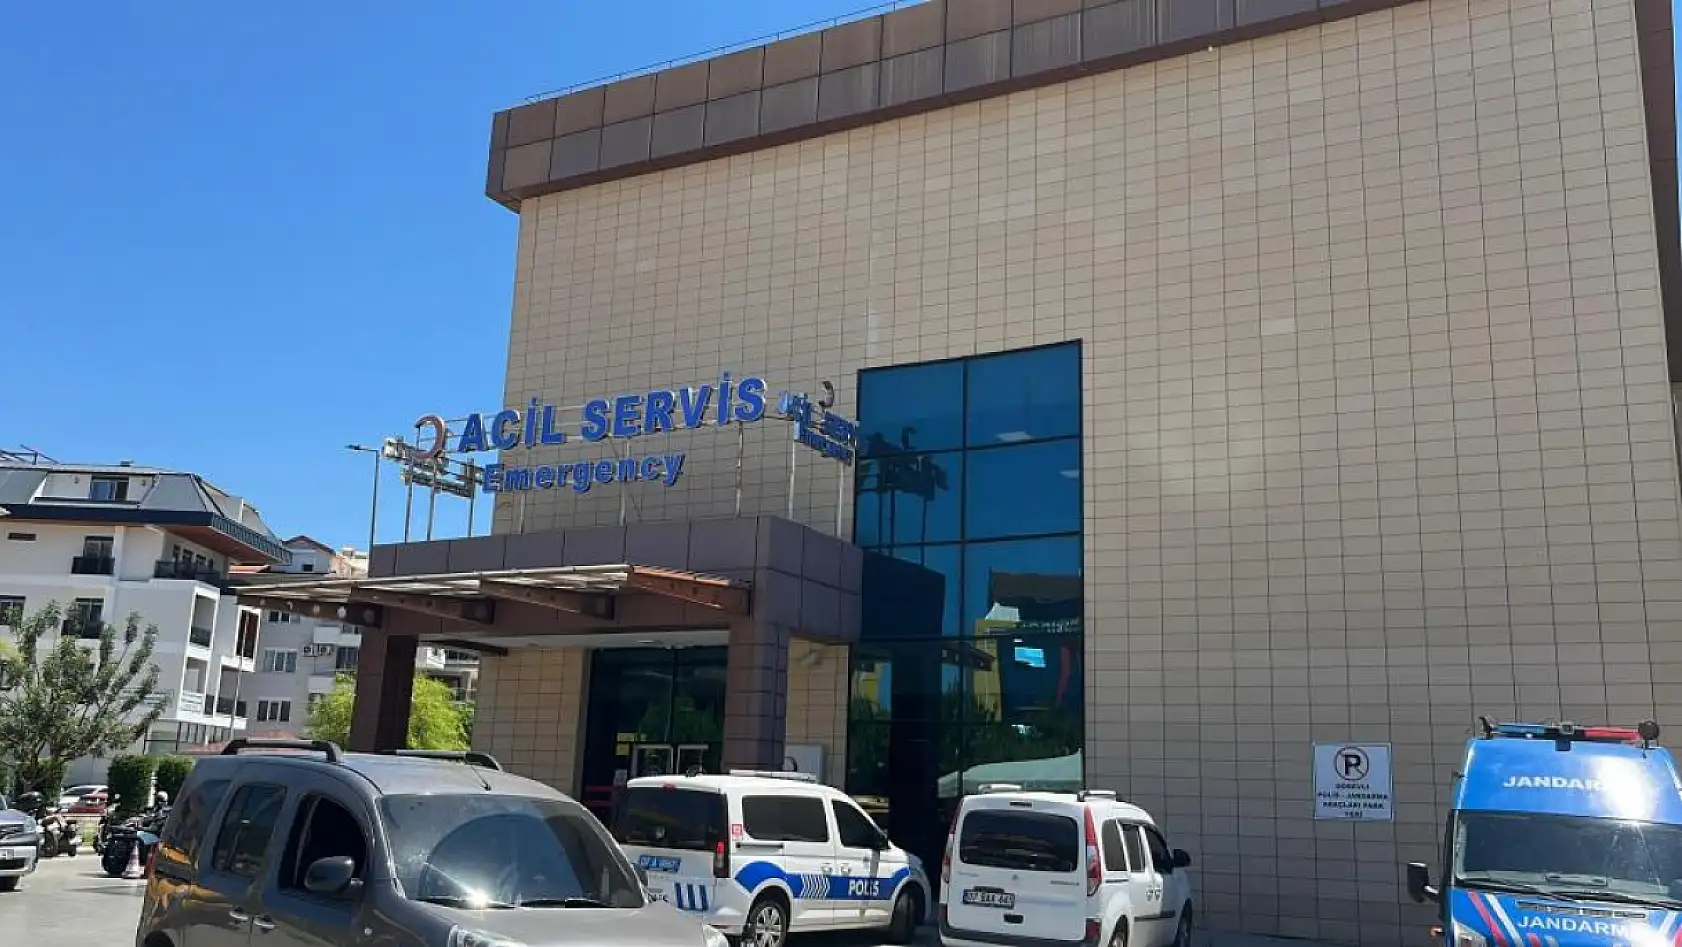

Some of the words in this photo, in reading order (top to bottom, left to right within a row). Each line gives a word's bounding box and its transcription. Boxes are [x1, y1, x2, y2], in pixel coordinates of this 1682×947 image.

[457, 397, 566, 453] ACİL
[580, 371, 767, 442] SERVİS
[481, 453, 686, 493] Emergency
[1503, 775, 1606, 792] JANDAR
[1518, 915, 1629, 938] JANDARM
